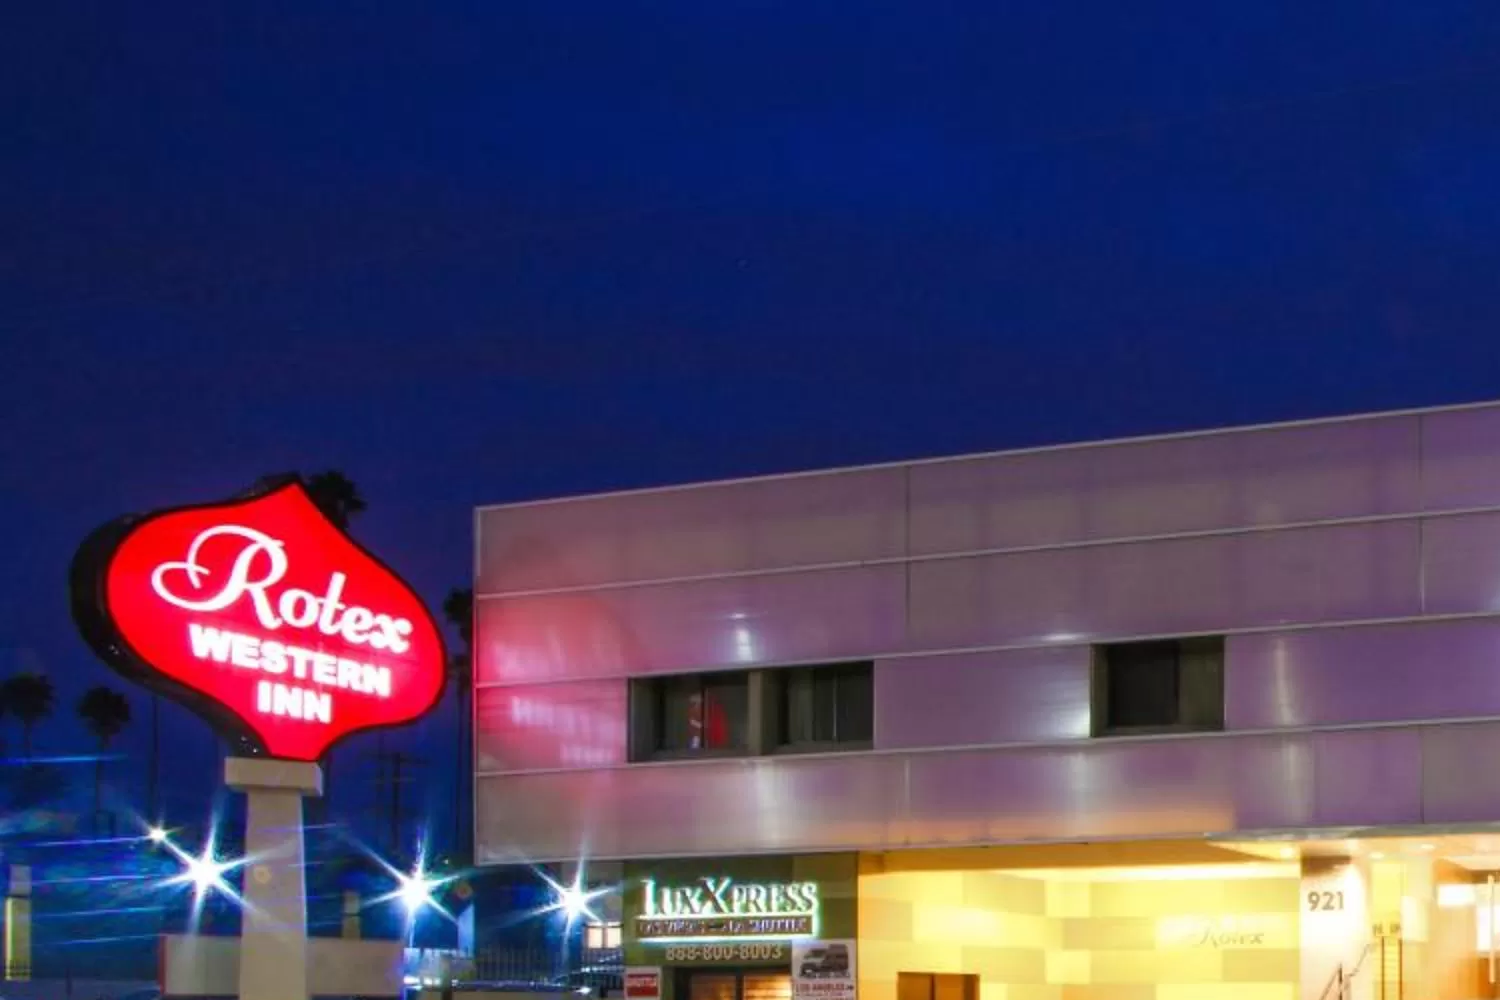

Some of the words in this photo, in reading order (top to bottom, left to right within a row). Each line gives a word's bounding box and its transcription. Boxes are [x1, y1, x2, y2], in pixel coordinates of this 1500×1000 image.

[151, 525, 413, 653] Rotex
[188, 624, 391, 698] WESTERN
[257, 681, 332, 723] INN
[1307, 890, 1344, 912] 921
